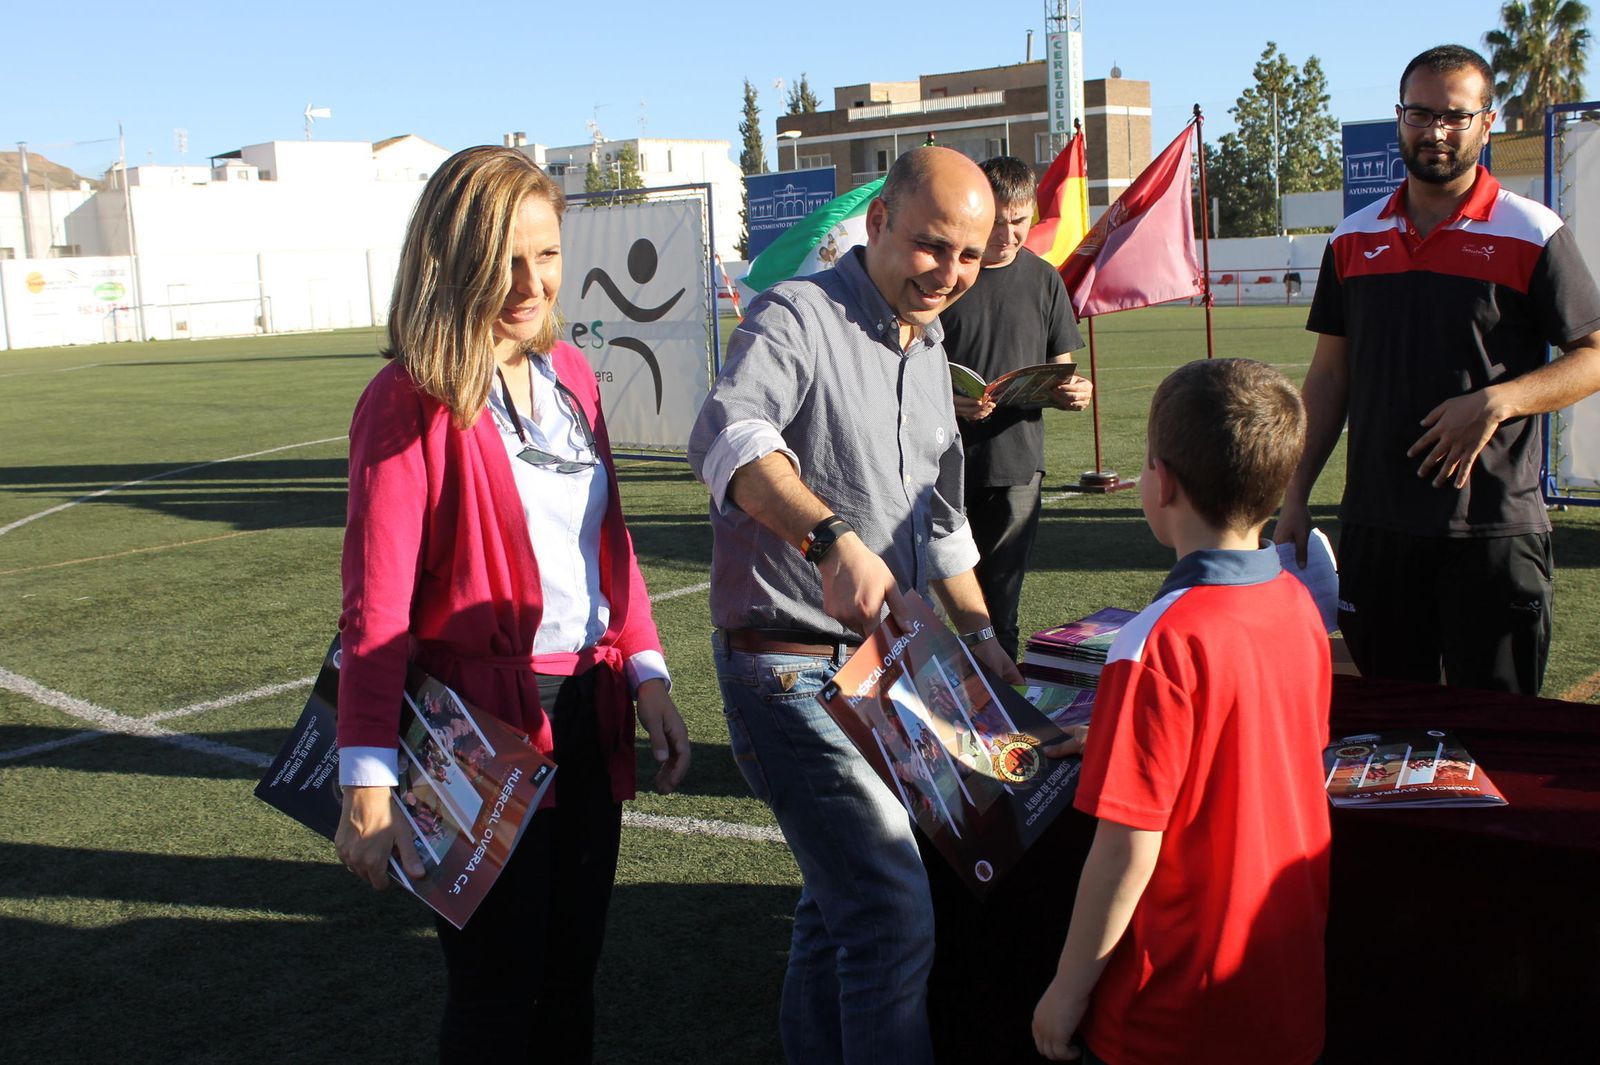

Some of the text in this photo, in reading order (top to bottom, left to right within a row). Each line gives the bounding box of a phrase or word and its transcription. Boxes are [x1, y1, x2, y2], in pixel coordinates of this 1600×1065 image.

[1053, 40, 1065, 131] CEREZUELA
[1348, 186, 1399, 195] AYUNTAMIEN
[571, 320, 604, 349] es
[883, 636, 910, 667] OVERA
[298, 749, 309, 760] DE
[282, 757, 303, 784] CROMOS
[312, 763, 334, 789] CROMOS
[1040, 782, 1052, 794] DE
[1046, 760, 1071, 786] CROMOS
[465, 828, 494, 872] OVERA
[448, 874, 468, 895] C.F.
